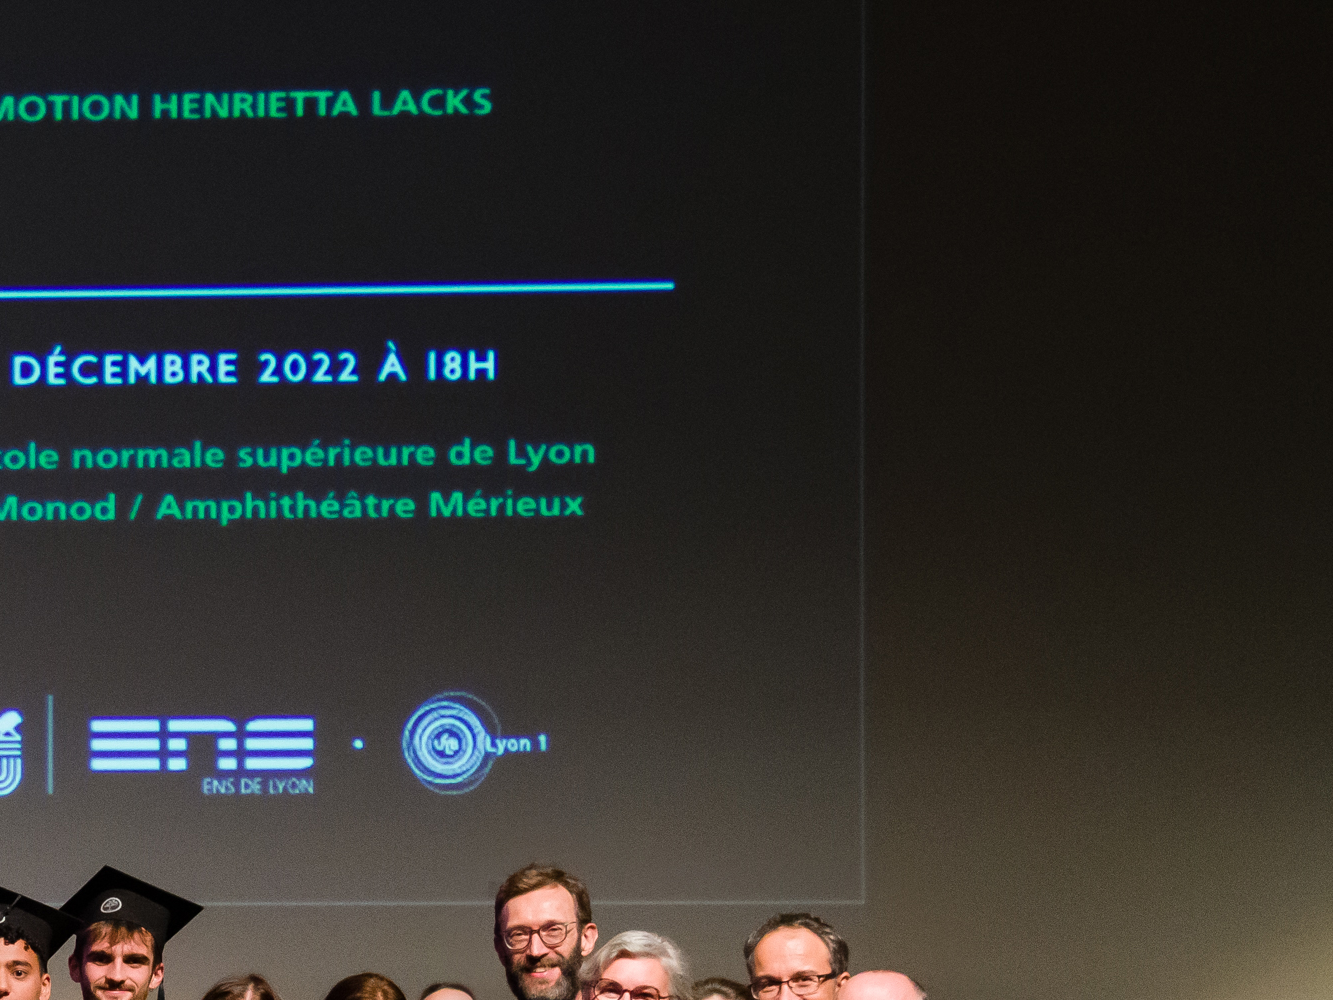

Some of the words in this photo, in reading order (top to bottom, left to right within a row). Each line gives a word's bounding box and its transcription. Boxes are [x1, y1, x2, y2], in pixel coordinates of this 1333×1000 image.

[152, 89, 359, 120] HENRIETTA
[371, 87, 492, 117] LACKS
[11, 344, 239, 386] DÉCEMBRE
[257, 351, 360, 384] 2022
[377, 340, 408, 383] À
[427, 349, 495, 382] 18H
[71, 440, 226, 470] normale
[237, 438, 436, 475] supérieure
[448, 436, 495, 466] de
[508, 438, 595, 472] Lyon
[128, 493, 144, 521] /
[155, 490, 416, 527] Amphithéâtre
[429, 489, 584, 518] Mérieux
[485, 733, 531, 757] Lyon
[537, 732, 548, 752] 1
[202, 777, 235, 795] ENS
[240, 777, 261, 795] DE
[268, 777, 314, 795] LYON
